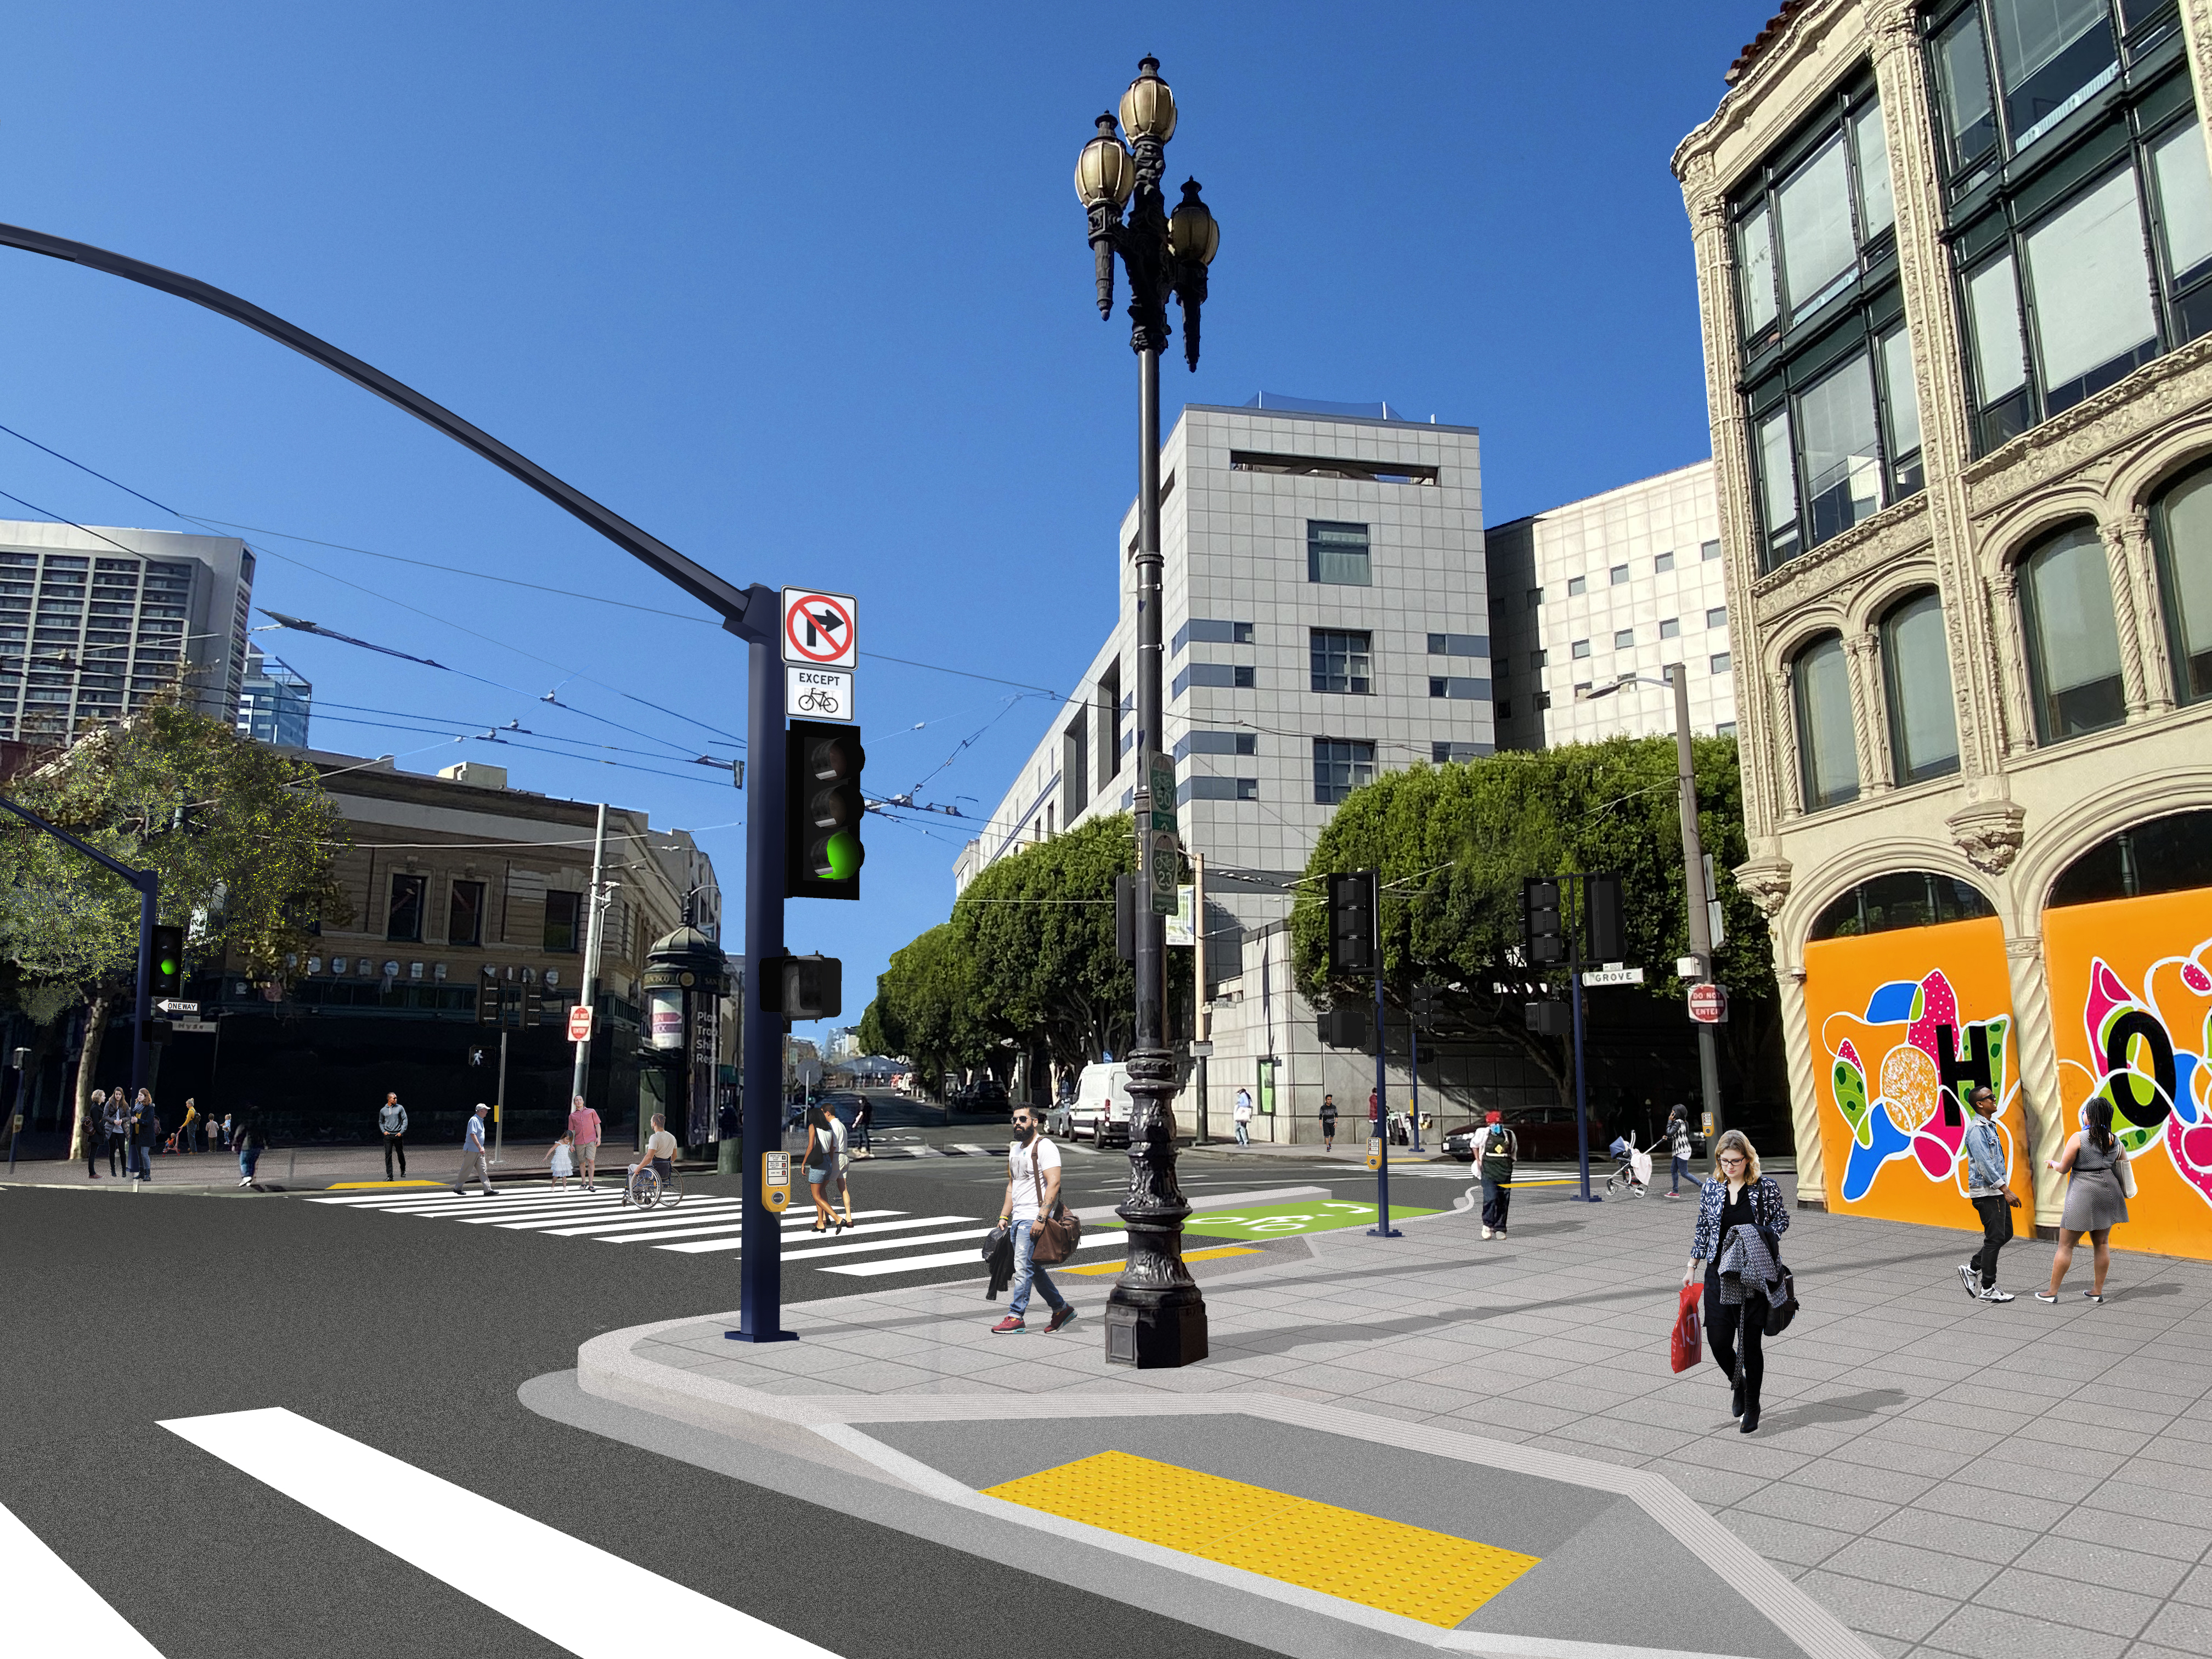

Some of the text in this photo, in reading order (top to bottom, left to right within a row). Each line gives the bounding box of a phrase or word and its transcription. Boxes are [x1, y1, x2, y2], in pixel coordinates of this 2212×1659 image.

[799, 673, 840, 686] EXCEPT
[1156, 790, 1171, 806] 50
[1158, 871, 1172, 887] 23
[1595, 972, 1633, 982] GROVE
[1936, 1011, 2176, 1128] H O
